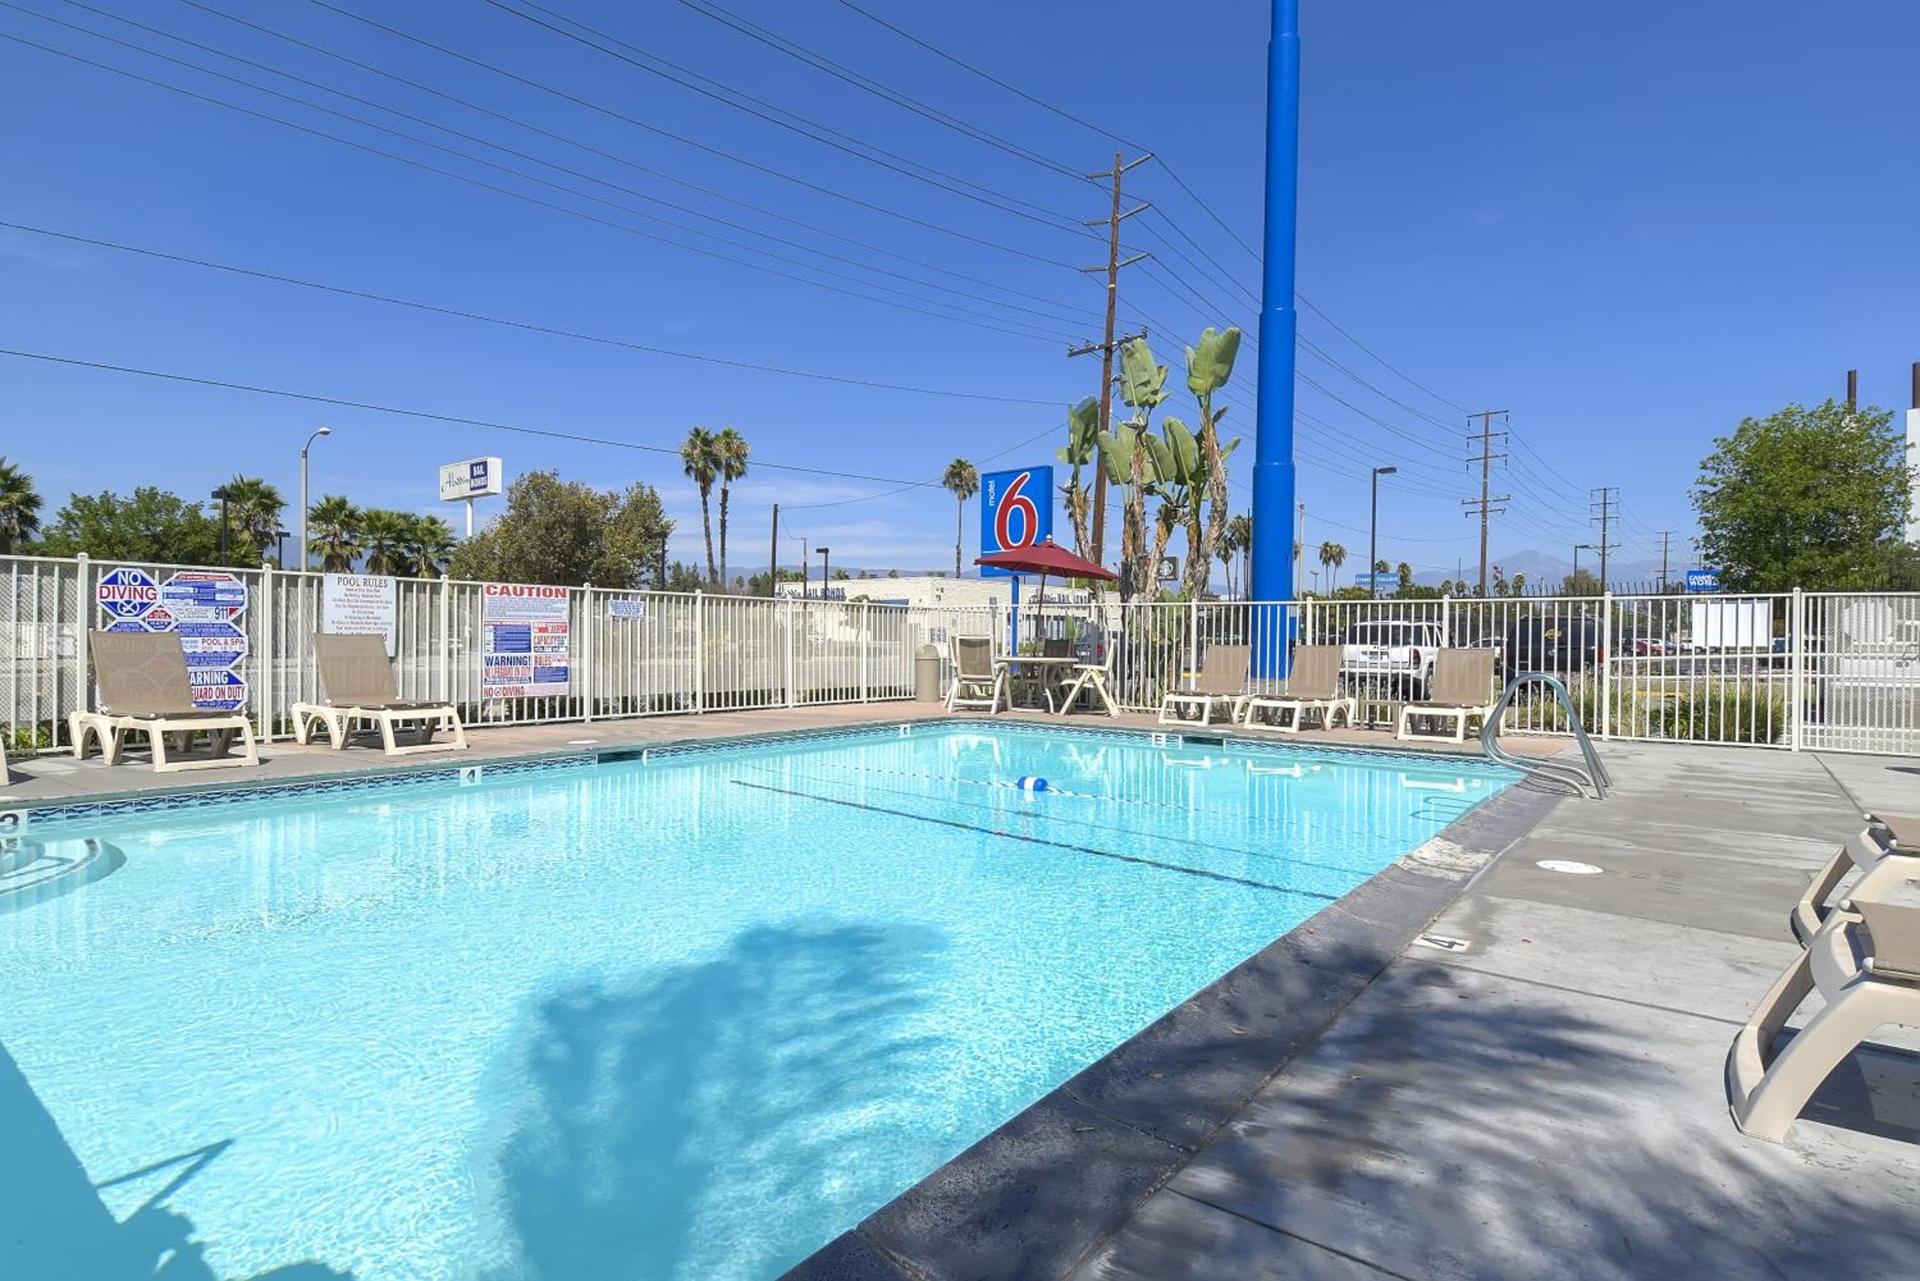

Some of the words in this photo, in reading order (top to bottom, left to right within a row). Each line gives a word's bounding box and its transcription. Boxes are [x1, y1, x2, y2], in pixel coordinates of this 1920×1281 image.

[994, 471, 1038, 551] 6
[117, 571, 142, 586] NO
[337, 576, 361, 587] POOL
[363, 577, 388, 588] RULES
[99, 585, 157, 600] DIVING
[485, 584, 567, 598] CAUTION
[214, 607, 229, 620] 911
[201, 638, 222, 646] POOL
[230, 638, 245, 646] SPA
[484, 655, 531, 667] WARNING!
[189, 671, 229, 685] ARNING
[215, 687, 226, 699] ON
[227, 686, 245, 699] DUTY
[484, 687, 494, 698] NO
[502, 686, 526, 697] DIVING
